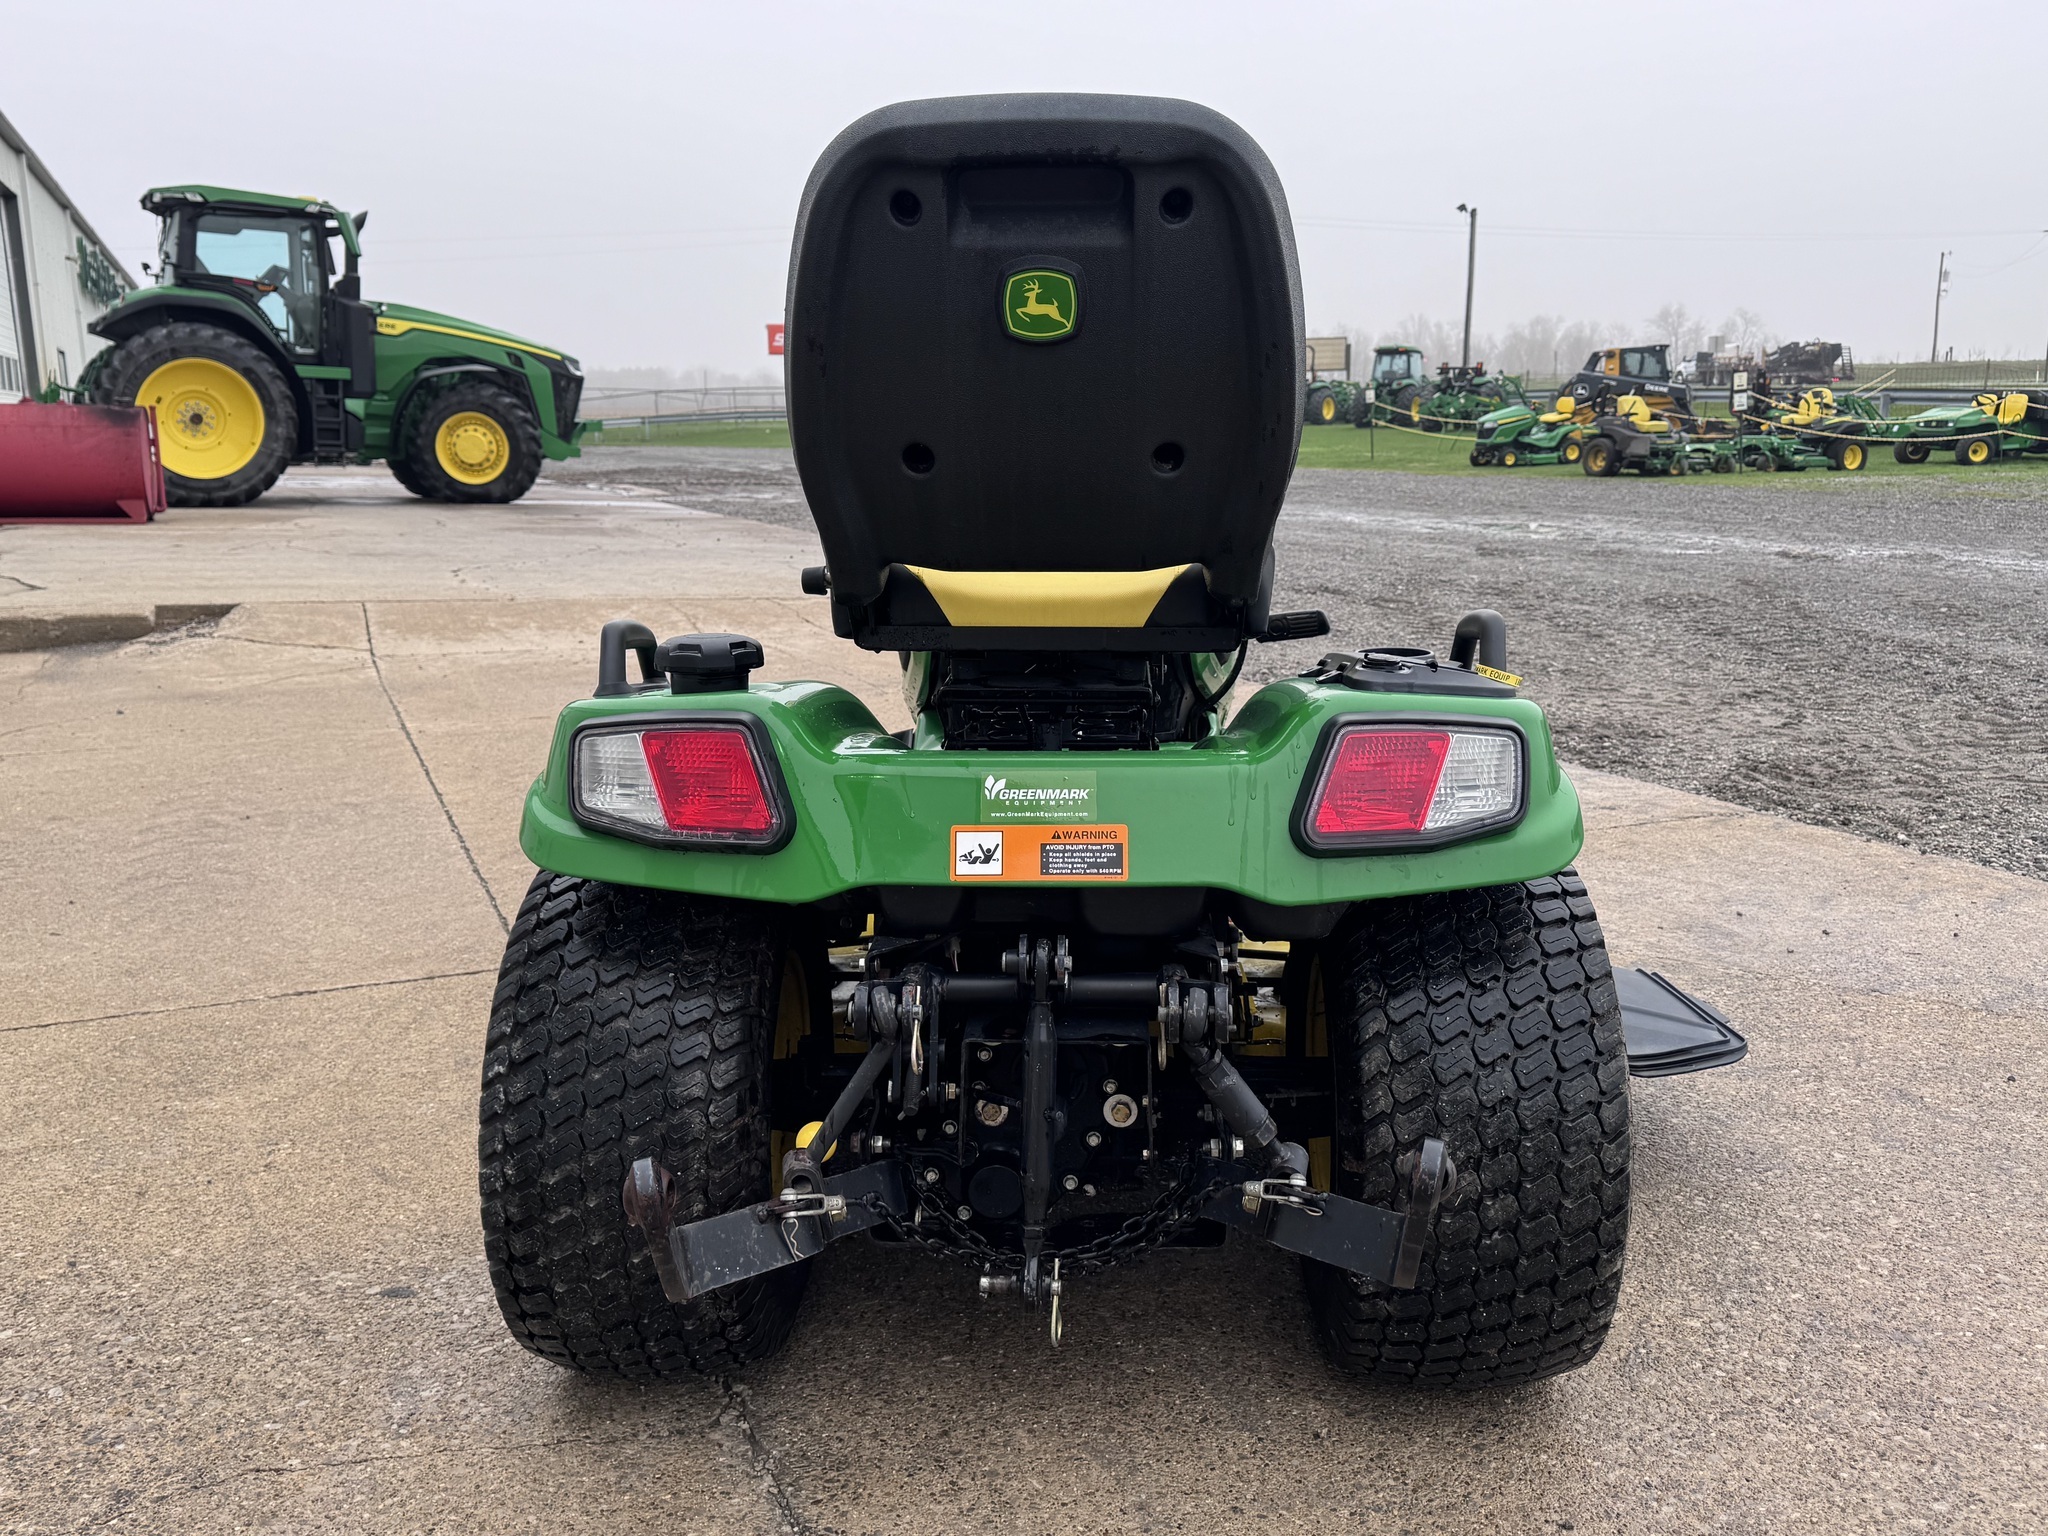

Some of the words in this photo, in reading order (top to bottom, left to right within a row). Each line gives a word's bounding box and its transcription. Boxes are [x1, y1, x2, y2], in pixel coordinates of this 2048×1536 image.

[772, 332, 785, 346] S
[1644, 383, 1669, 393] DEERE
[1489, 670, 1511, 682] EQUIP
[999, 789, 1090, 800] GREENMARK
[1062, 830, 1118, 840] WARNING
